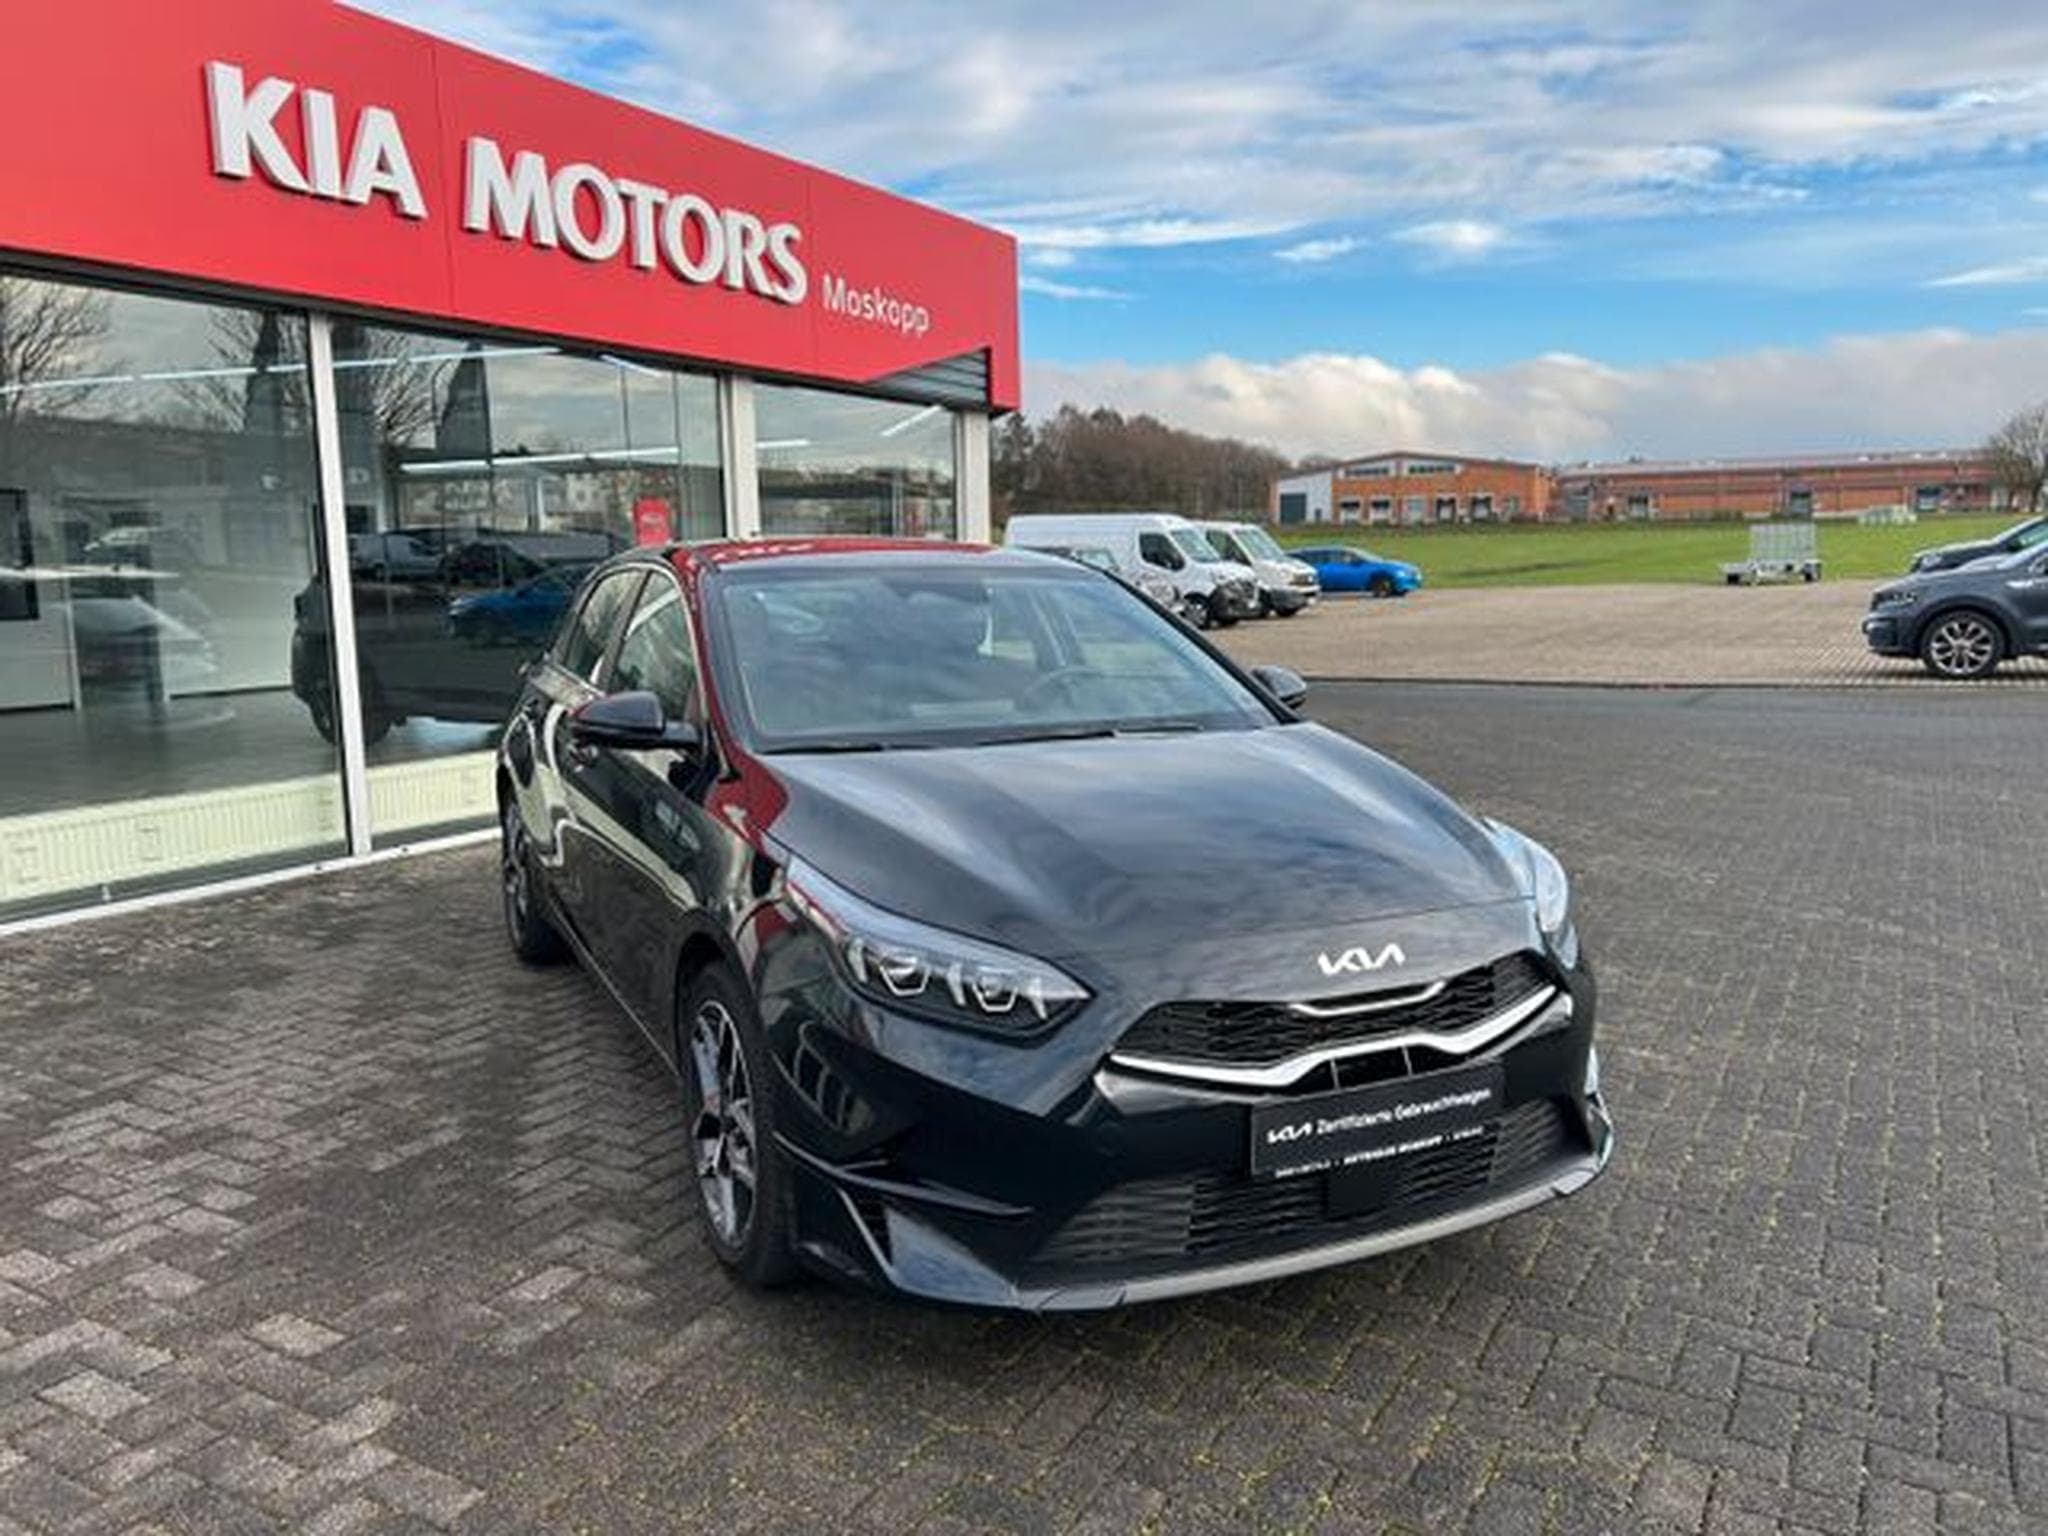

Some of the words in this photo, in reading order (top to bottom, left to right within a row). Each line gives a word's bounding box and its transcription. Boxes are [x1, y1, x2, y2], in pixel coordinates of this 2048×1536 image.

[205, 60, 427, 219] KIA
[464, 136, 808, 306] MOTORS
[822, 272, 930, 337] Moskopp
[1317, 943, 1405, 976] KIA
